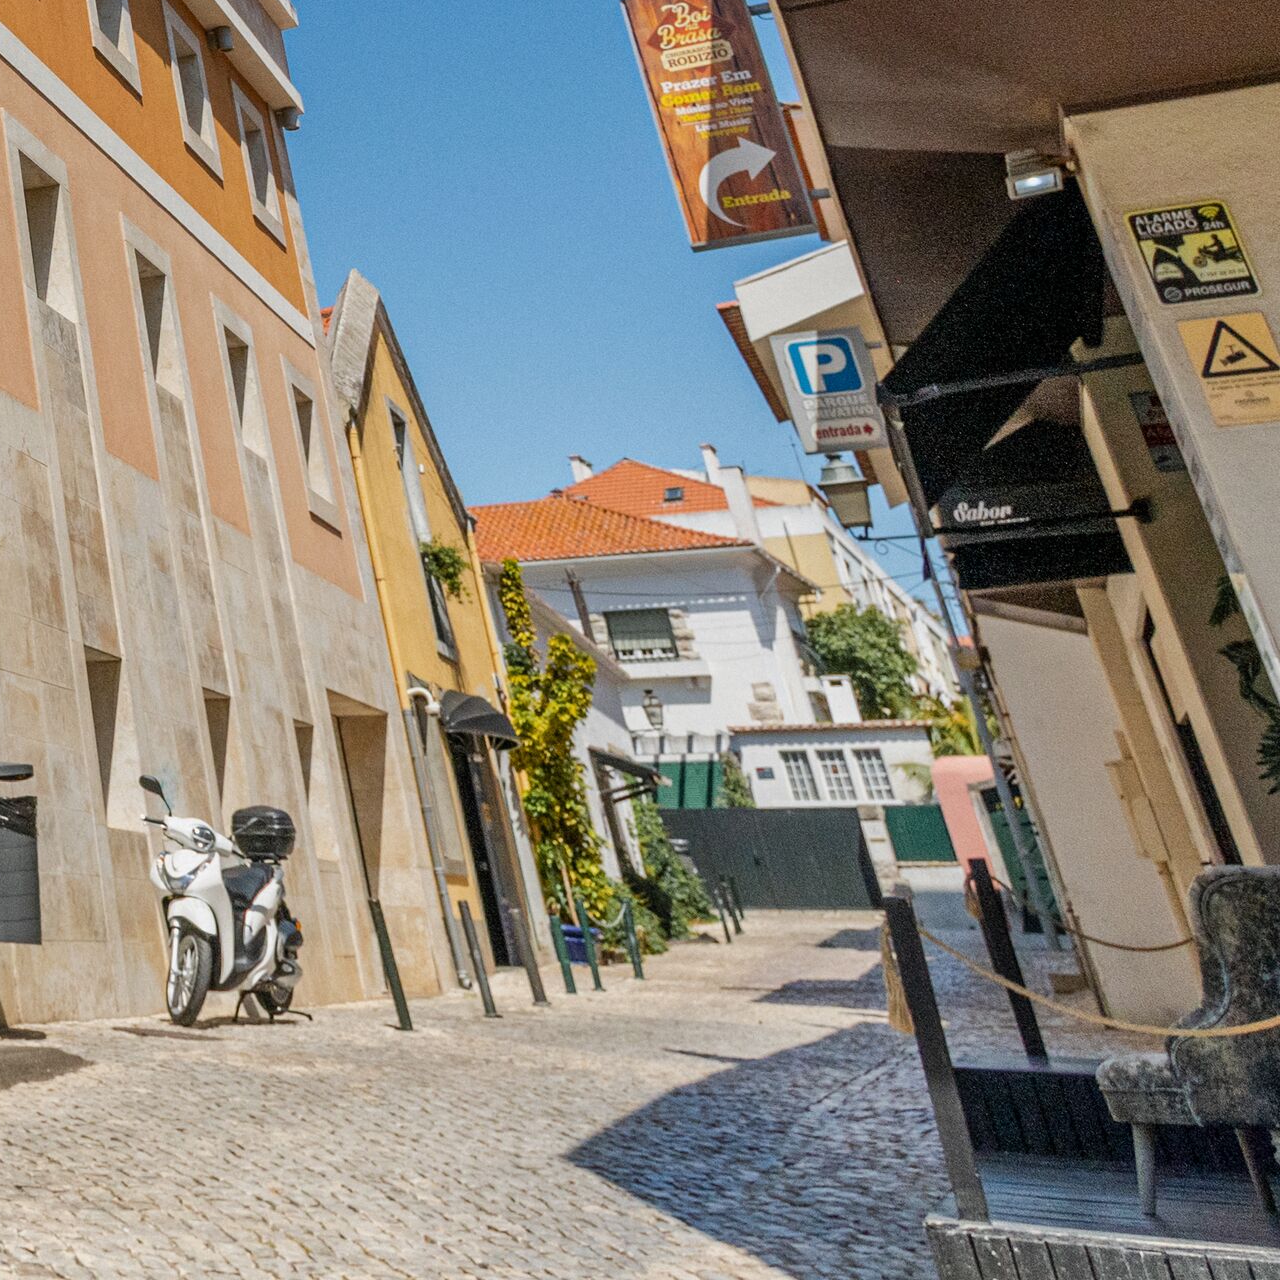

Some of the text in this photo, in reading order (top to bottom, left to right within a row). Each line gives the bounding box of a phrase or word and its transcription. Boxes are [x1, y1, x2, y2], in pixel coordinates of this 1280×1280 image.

[661, 2, 711, 28] Boi
[657, 24, 721, 49] Brasa
[668, 48, 728, 68] RODIZIO
[660, 70, 752, 93] Prazer Em
[660, 81, 761, 107] Comer Bem
[722, 189, 791, 208] Entrada
[1135, 210, 1194, 225] ALARME
[1137, 219, 1198, 235] LIGADO
[1203, 221, 1225, 230] 24h
[1184, 281, 1251, 297] PROSEGUR
[798, 344, 846, 393] P
[816, 423, 861, 439] entrada
[953, 501, 1012, 522] Sabor
